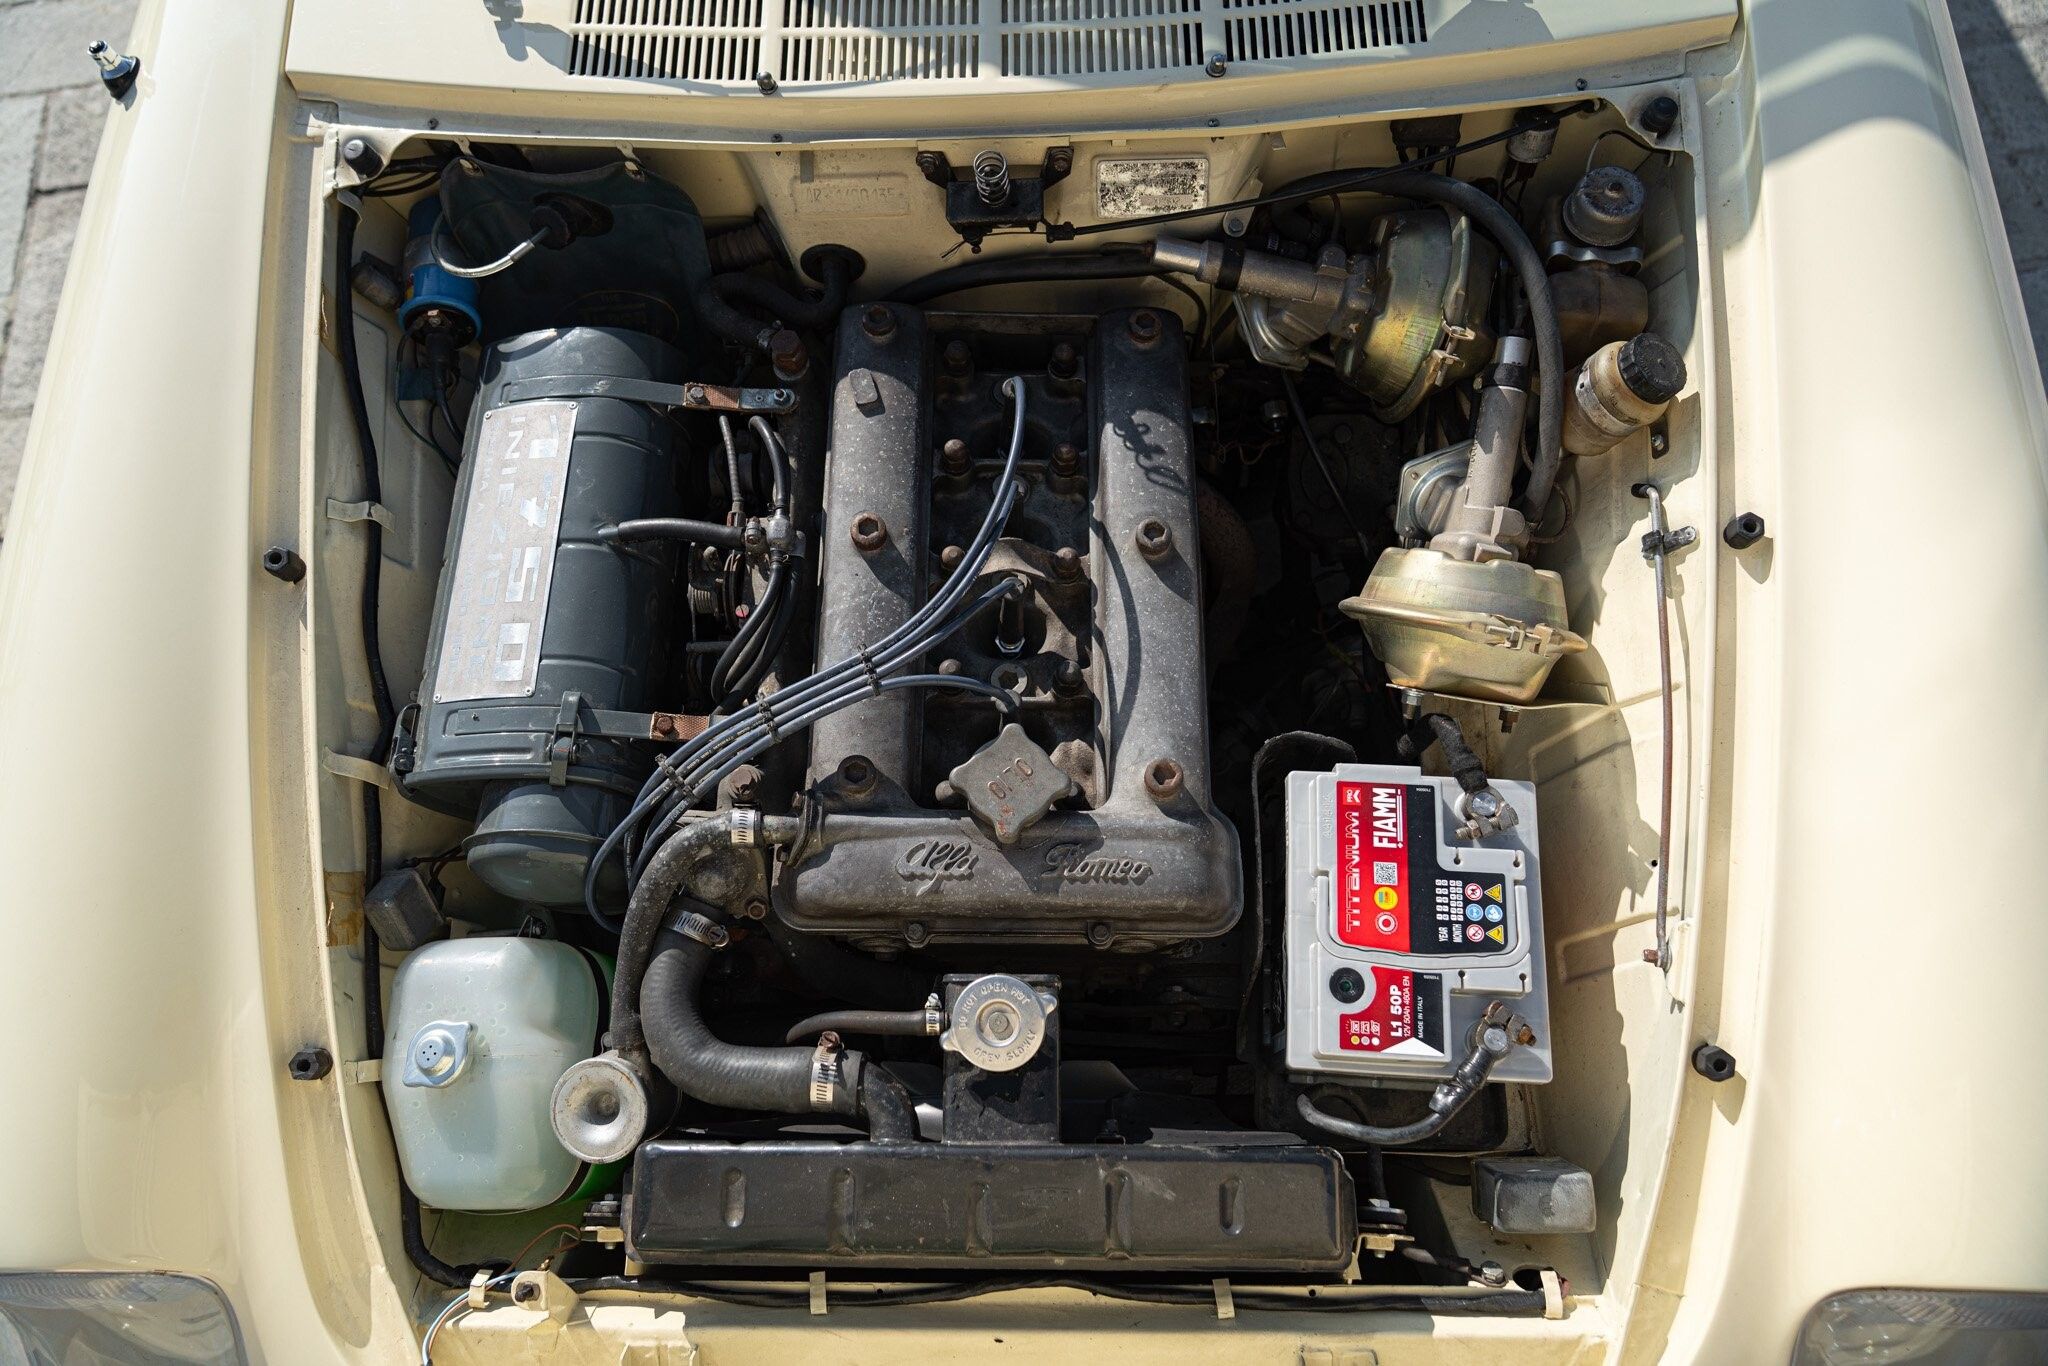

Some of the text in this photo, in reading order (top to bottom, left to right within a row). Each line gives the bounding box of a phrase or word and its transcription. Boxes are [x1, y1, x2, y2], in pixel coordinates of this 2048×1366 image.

[493, 414, 560, 682] 1750
[986, 756, 1036, 800] OLIO
[1372, 787, 1397, 849] FIAMM
[895, 840, 1155, 896] Alfa Romeo
[1438, 927, 1448, 942] YEAR
[1452, 924, 1462, 943] MONTH
[1402, 975, 1410, 986] EN
[958, 1016, 969, 1031] DO
[964, 992, 979, 1014] NOT
[980, 982, 1008, 995] OPEN
[1389, 984, 1402, 1037] L1 50P
[973, 1046, 1001, 1062] OPEN
